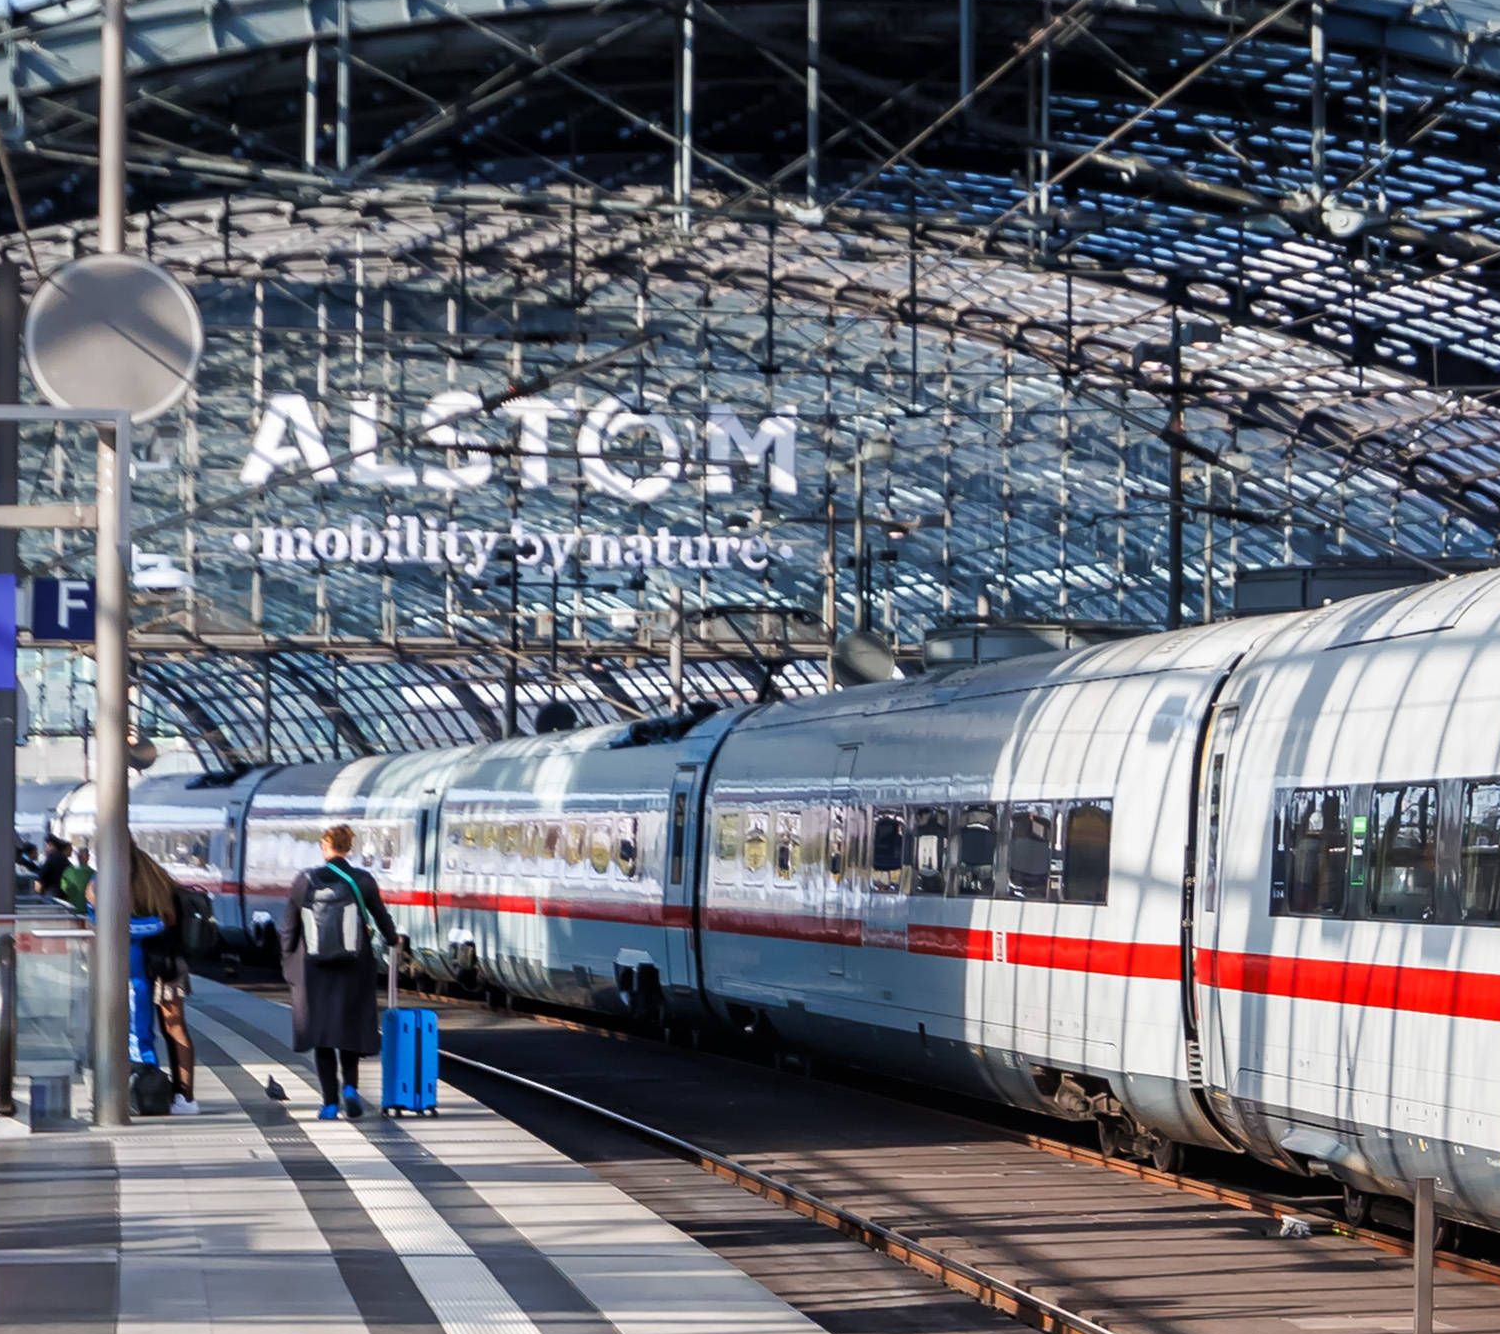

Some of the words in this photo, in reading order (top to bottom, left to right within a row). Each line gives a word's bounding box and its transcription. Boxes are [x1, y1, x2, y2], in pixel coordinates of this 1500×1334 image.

[239, 390, 798, 501] ALSTOM
[259, 515, 497, 576] mobility
[510, 519, 576, 575] by
[587, 526, 771, 570] nature
[57, 579, 91, 629] F
